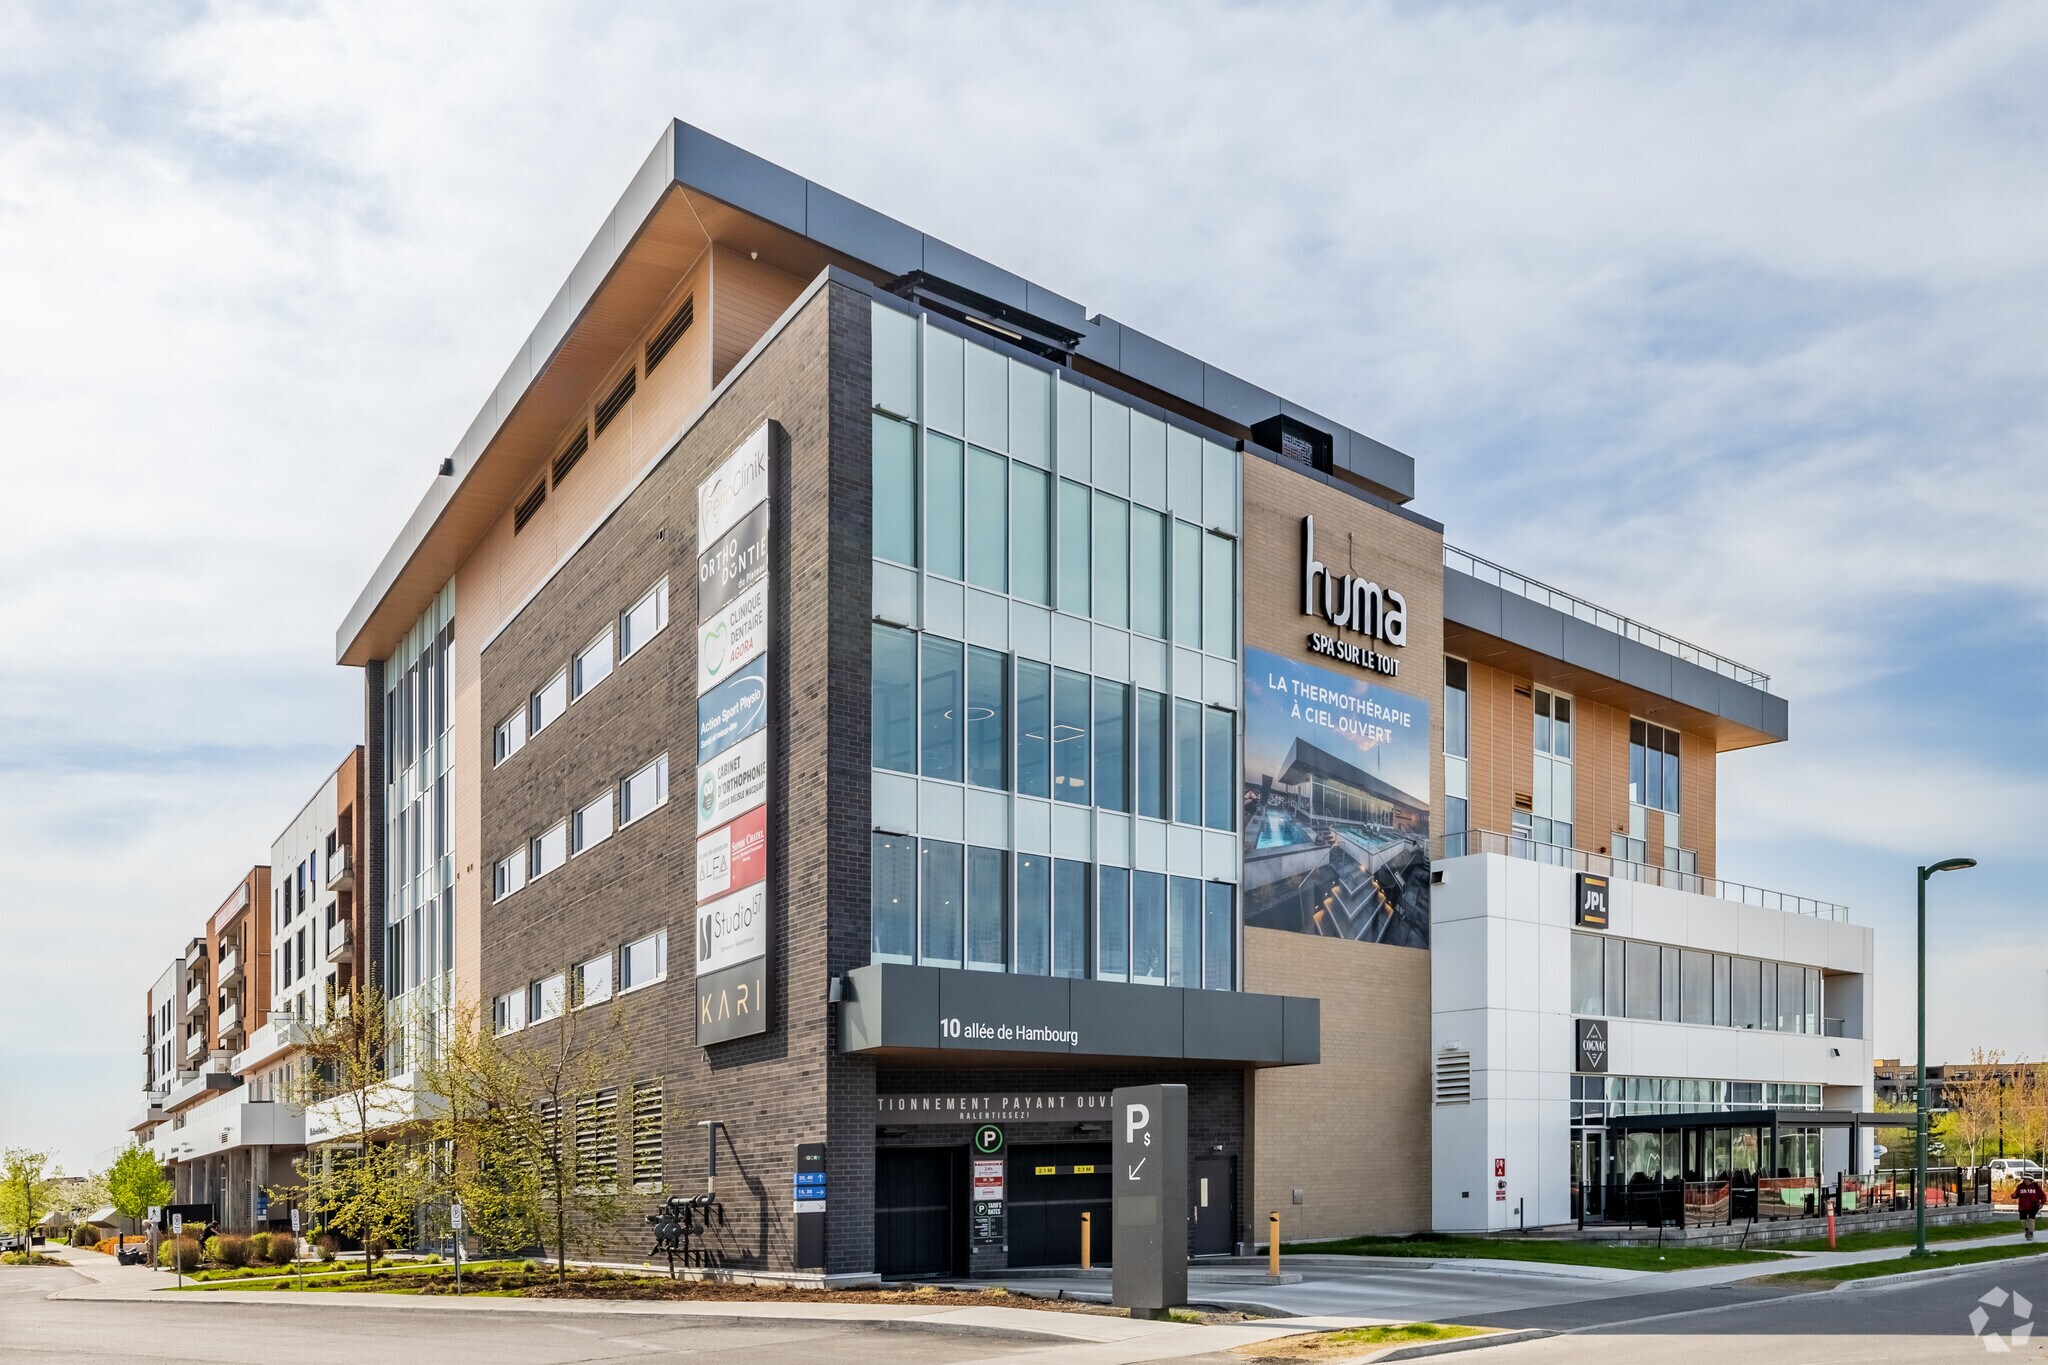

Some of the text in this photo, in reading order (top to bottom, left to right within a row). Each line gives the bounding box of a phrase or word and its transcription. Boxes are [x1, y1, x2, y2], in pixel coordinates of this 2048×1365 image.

[700, 538, 737, 582] ORTHO
[1303, 514, 1407, 647] huma
[730, 592, 761, 627] CLINIQUE
[730, 610, 763, 645] DENTAIRE
[730, 637, 754, 664] AGORA
[1312, 632, 1400, 677] SPA SUR LE TOIT
[701, 689, 760, 735] Action Sport Physio
[1268, 673, 1411, 728] LA THERMOTHÉRAPIE
[1290, 699, 1392, 744] À CIEL OUVERT
[717, 756, 741, 779] CABINET
[717, 761, 766, 798] D'ORTHOPHONIE
[1584, 890, 1606, 912] JPL
[701, 979, 760, 1025] KARI
[940, 1018, 1078, 1046] 10 allée de Hambourg
[1582, 1039, 1607, 1052] COGNAC
[1002, 1096, 1066, 1110] PAYANT
[1077, 1095, 1114, 1108] OUV
[984, 1131, 997, 1147] P
[1126, 1103, 1150, 1144] P
